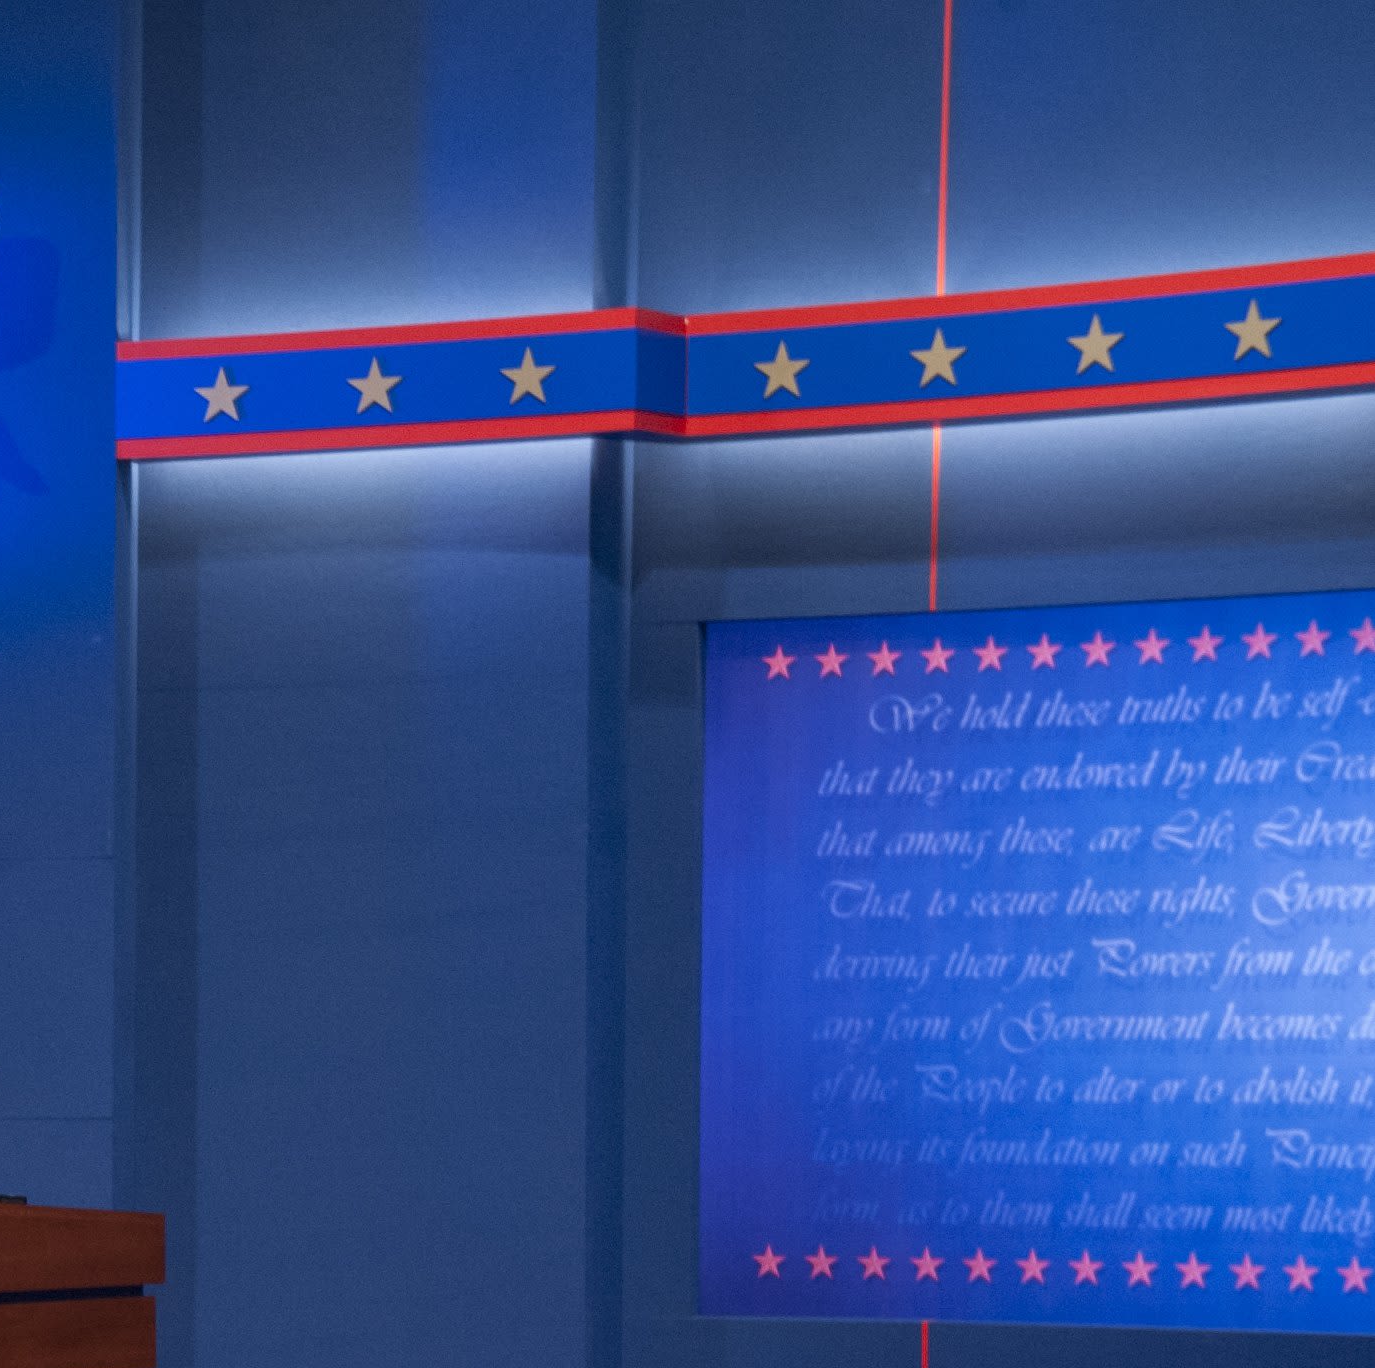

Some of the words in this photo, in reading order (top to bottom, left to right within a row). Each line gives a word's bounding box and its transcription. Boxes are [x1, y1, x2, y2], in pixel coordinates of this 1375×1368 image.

[868, 692, 952, 732] We
[961, 690, 1032, 729] hold
[1036, 689, 1111, 727] these
[1118, 684, 1205, 725] truths
[1213, 692, 1244, 721] to
[1252, 679, 1293, 720] be
[818, 760, 881, 796] that
[887, 757, 954, 807] they
[962, 767, 1014, 793] are
[1020, 749, 1160, 790] endowed
[1162, 747, 1206, 799] by
[1214, 746, 1286, 784] their
[817, 821, 878, 857] that
[884, 830, 994, 869] among
[1089, 825, 1143, 851] are
[926, 887, 956, 916] to
[964, 890, 1057, 917] secure
[1066, 877, 1141, 914] these
[814, 943, 938, 992] deriving
[944, 942, 1015, 978] their
[1002, 948, 1075, 992] just
[1091, 936, 1216, 977] Powers
[1210, 938, 1294, 991] from
[1302, 936, 1351, 976] the
[812, 1016, 875, 1053] any
[871, 1003, 951, 1053] form
[959, 1003, 1004, 1054] of
[999, 1002, 1210, 1053] Government
[1218, 1002, 1346, 1041] becomes
[851, 1065, 898, 1103] the
[915, 1062, 1028, 1115] People
[1035, 1075, 1065, 1103] to
[1074, 1066, 1144, 1103] alter
[1153, 1079, 1187, 1102] or
[1194, 1076, 1224, 1103] to
[1233, 1066, 1340, 1104] abolish
[917, 1135, 953, 1163] its
[950, 1126, 1120, 1176] foundation
[1130, 1141, 1170, 1166] on
[1178, 1129, 1248, 1167] such
[941, 1196, 970, 1224] to
[979, 1190, 1053, 1226] them
[1060, 1191, 1137, 1228] shall
[1142, 1204, 1213, 1230] seem
[1222, 1205, 1292, 1231] most
